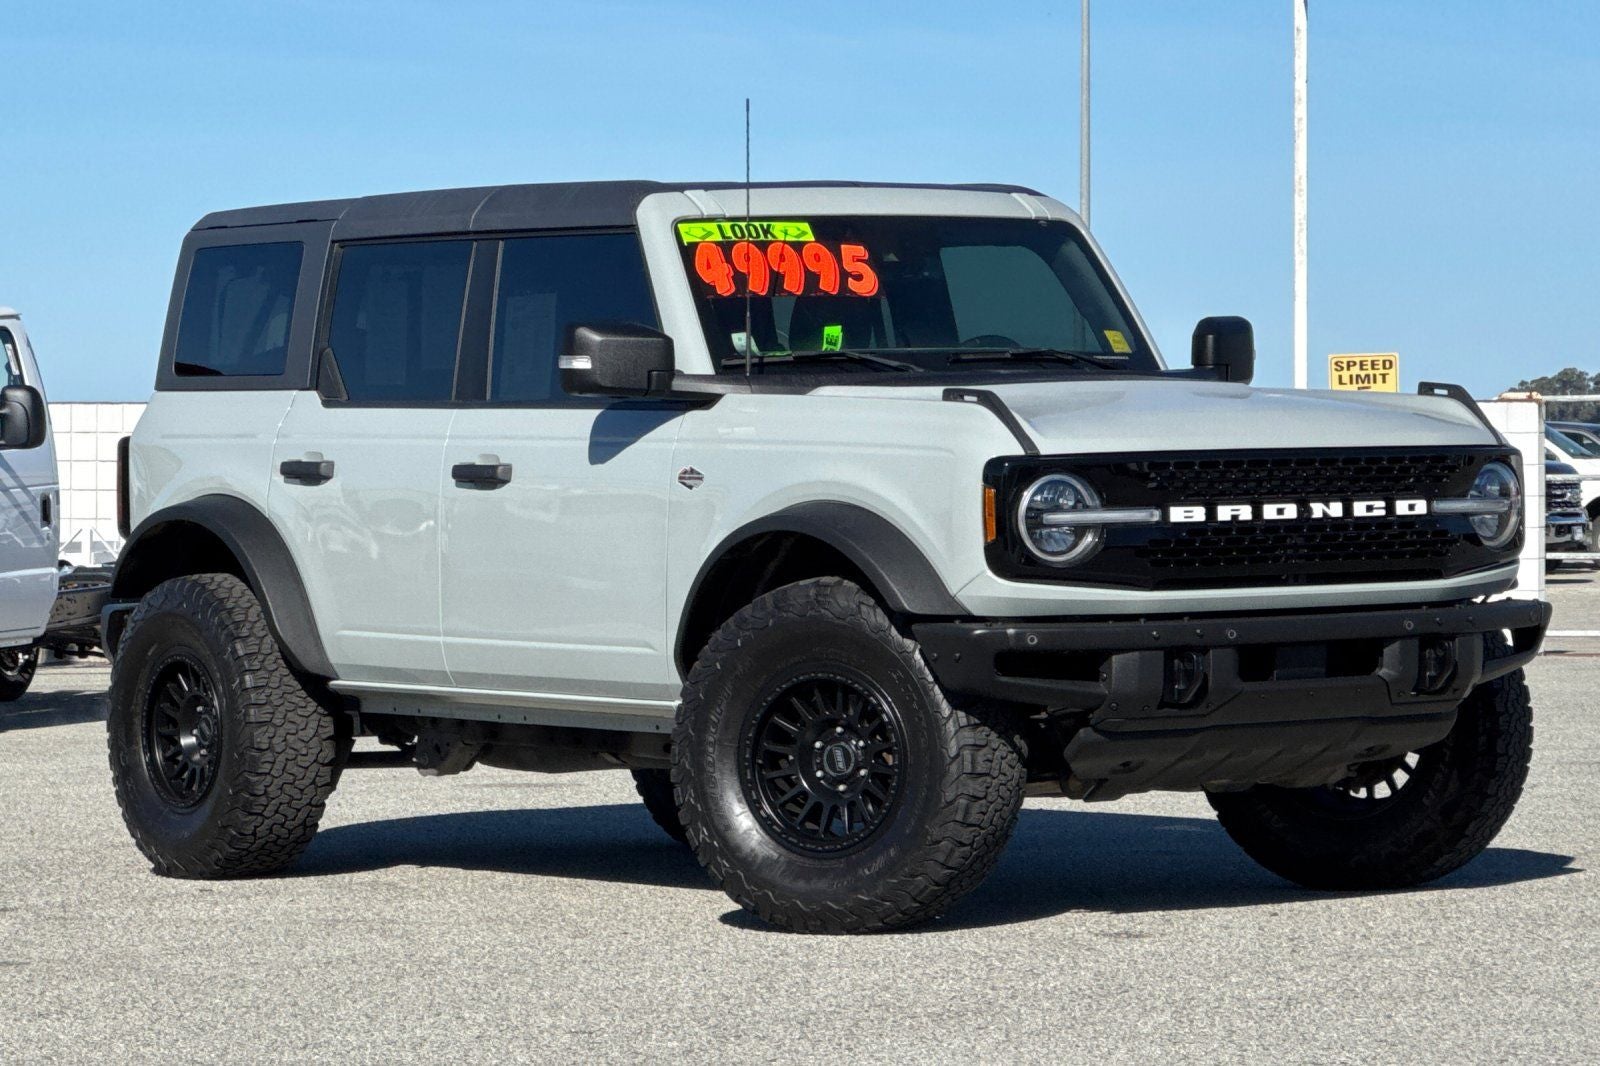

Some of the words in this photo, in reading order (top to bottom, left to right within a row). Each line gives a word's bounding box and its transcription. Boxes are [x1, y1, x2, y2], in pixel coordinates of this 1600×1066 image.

[716, 223, 779, 240] LOOK
[695, 241, 878, 297] 49995
[1333, 359, 1393, 372] SPEED
[1338, 373, 1389, 386] LIMIT
[1169, 500, 1428, 522] BRONCO
